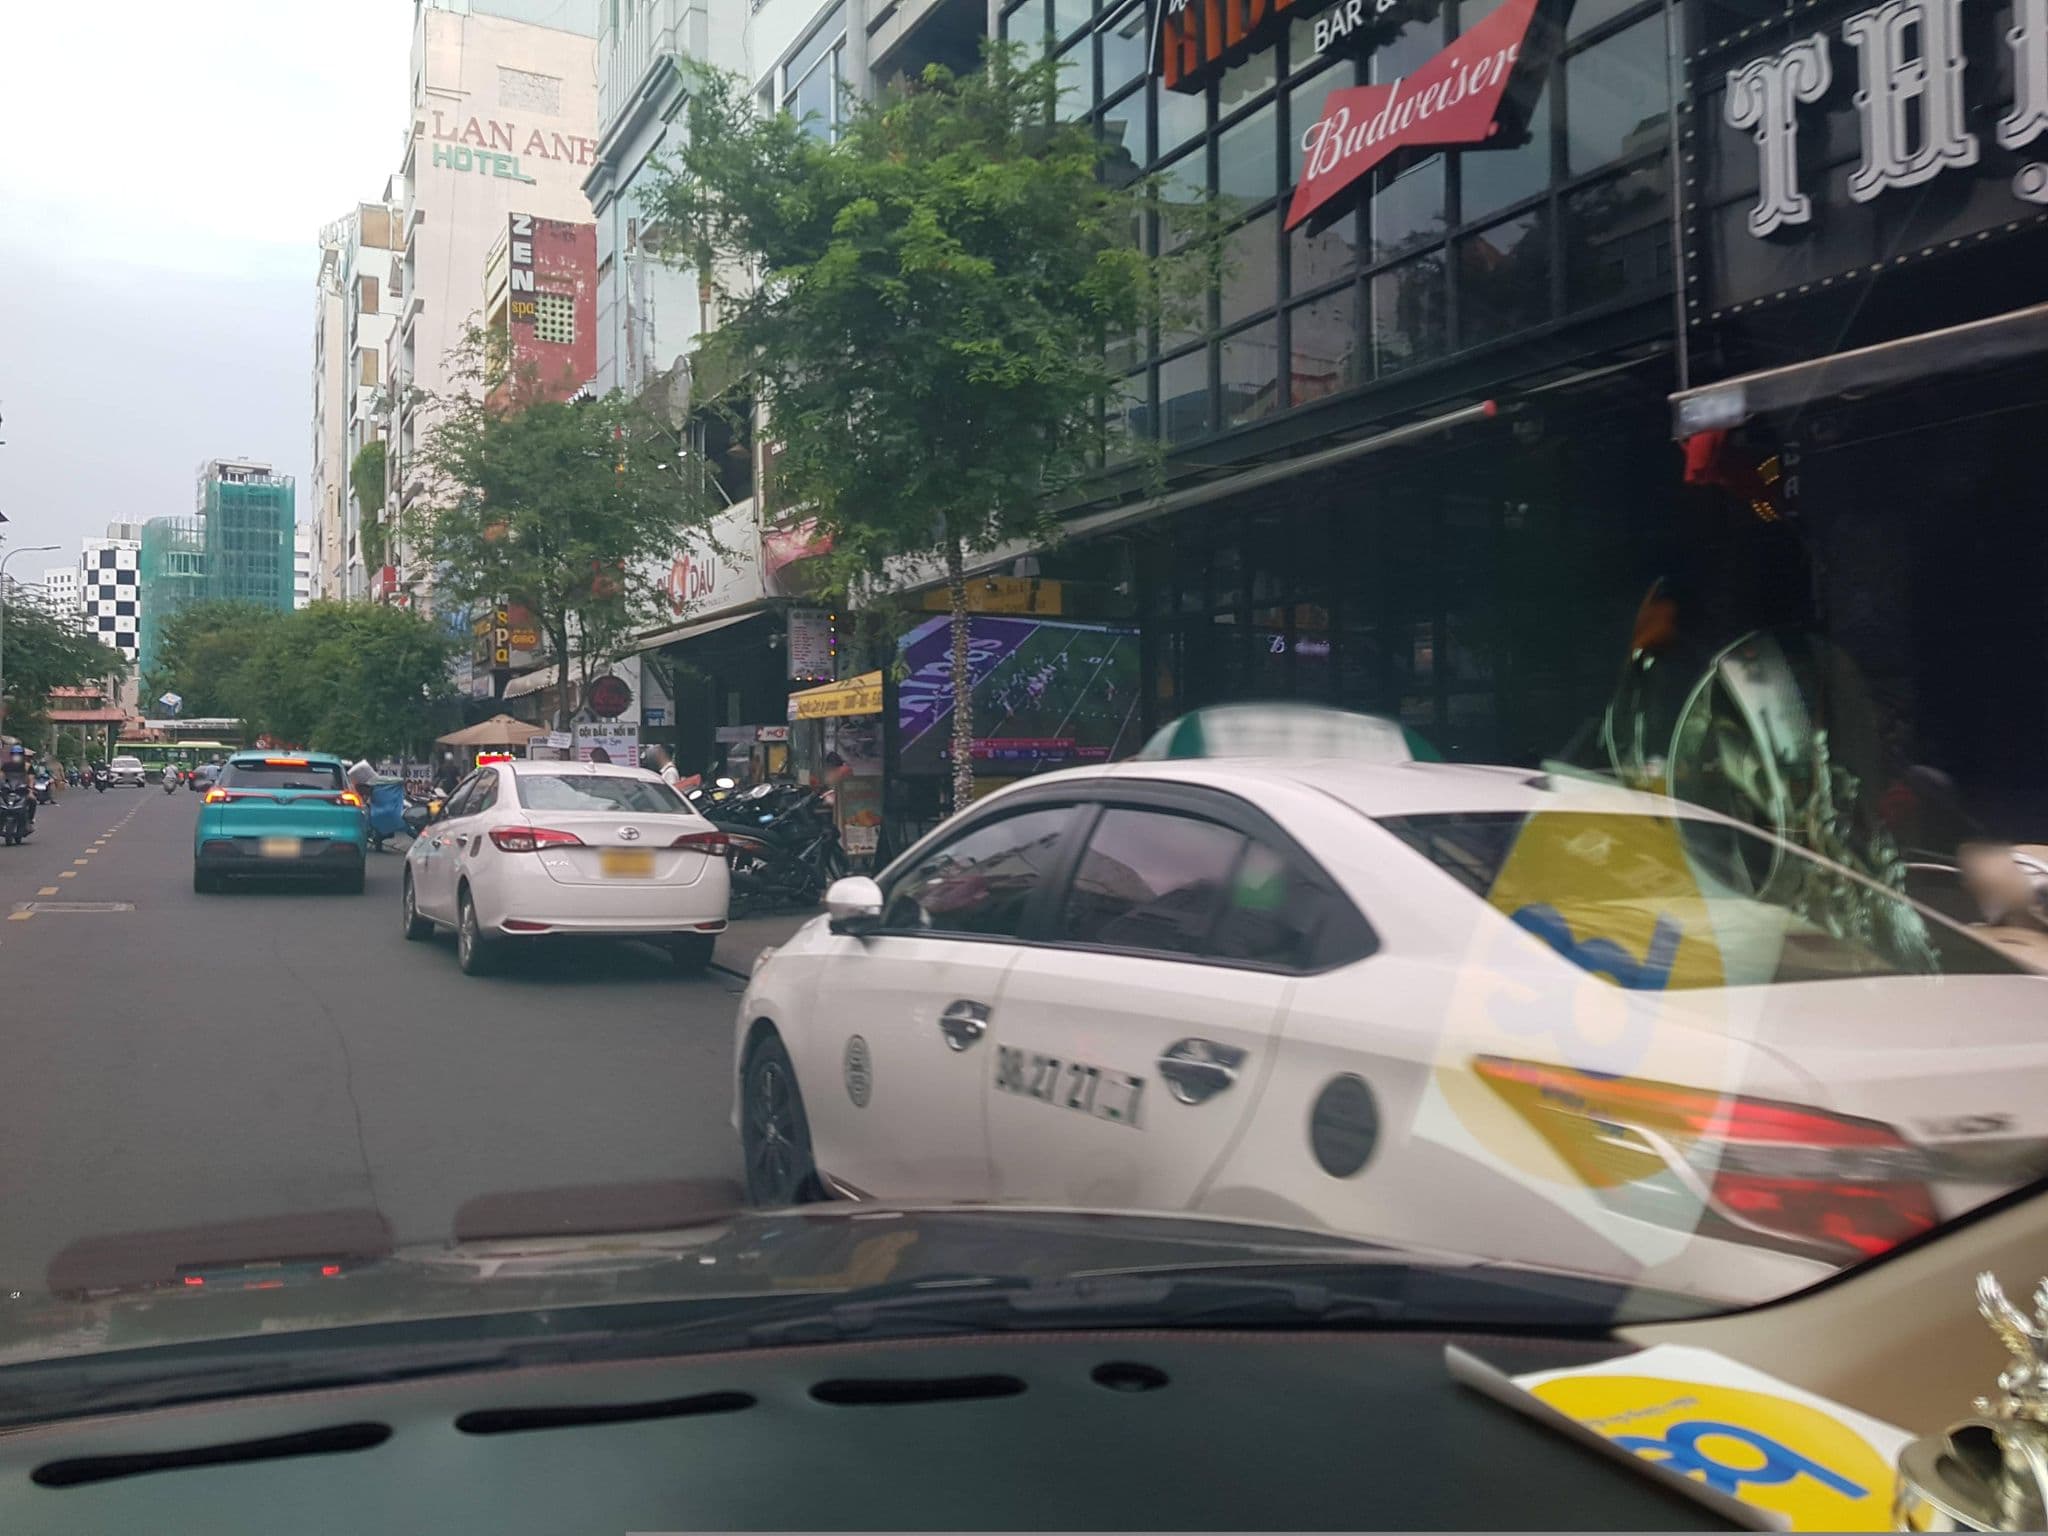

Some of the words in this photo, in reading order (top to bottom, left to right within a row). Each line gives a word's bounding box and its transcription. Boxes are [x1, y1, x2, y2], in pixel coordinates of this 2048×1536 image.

[1163, 0, 1298, 90] HID
[1313, 0, 1362, 53] BAR
[432, 110, 515, 152] LAN
[523, 129, 600, 167] ANH
[1301, 42, 1518, 181] Budweiser
[432, 143, 537, 186] HOTEL
[511, 214, 534, 292] ZEN
